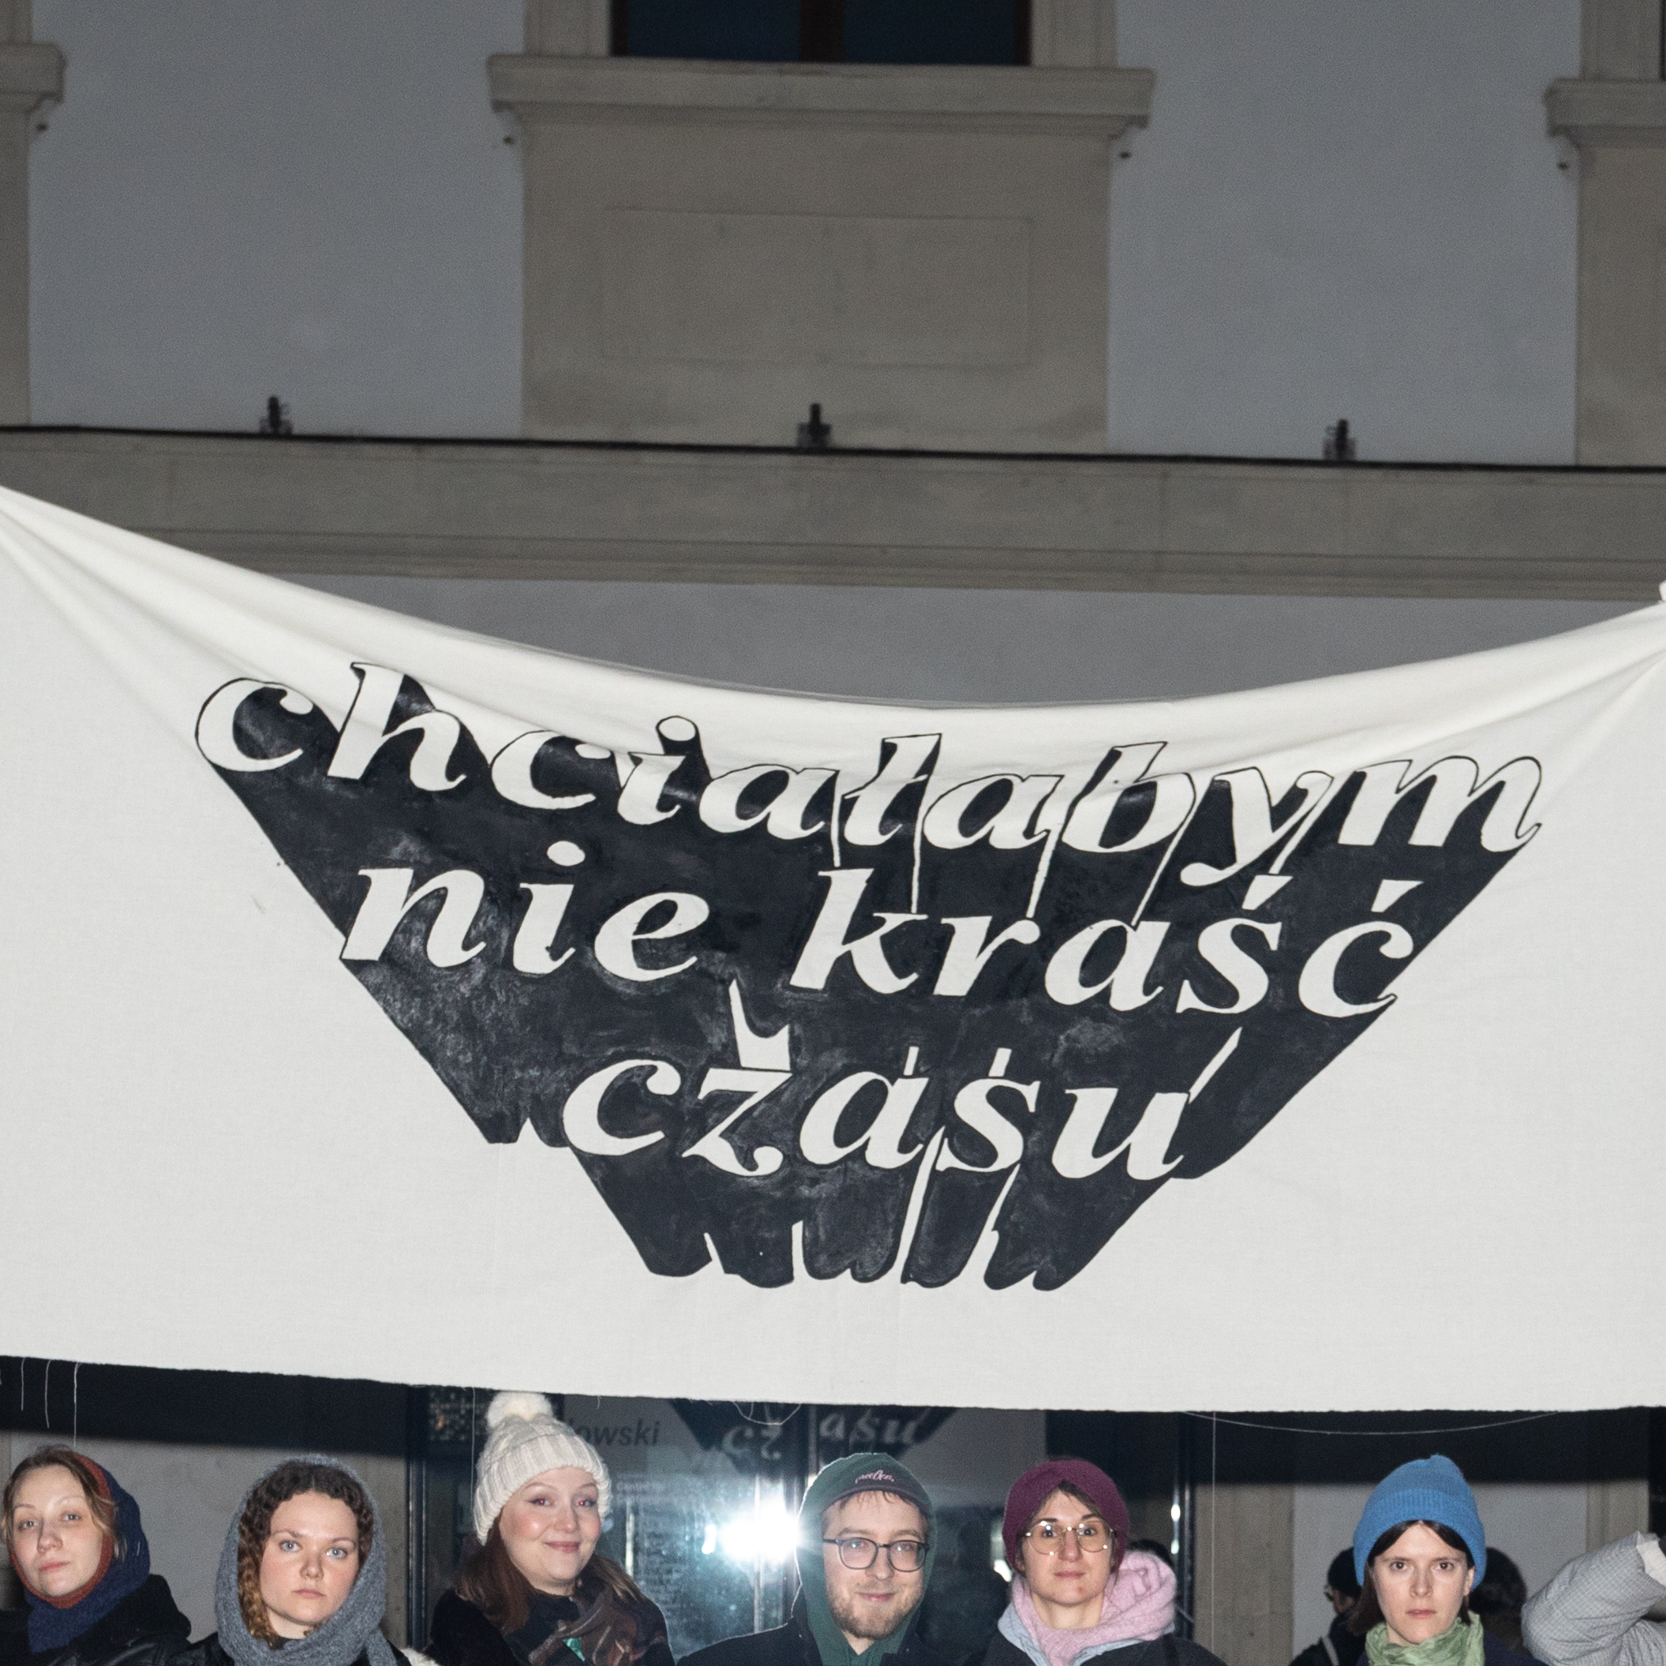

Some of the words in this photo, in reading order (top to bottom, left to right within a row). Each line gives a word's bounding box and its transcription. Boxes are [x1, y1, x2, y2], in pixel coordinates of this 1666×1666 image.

[195, 660, 1542, 887] chciałabym
[340, 840, 710, 982] nie
[789, 867, 1424, 1018] kraść
[562, 1058, 1186, 1181] czasu
[568, 1417, 661, 1446] owski
